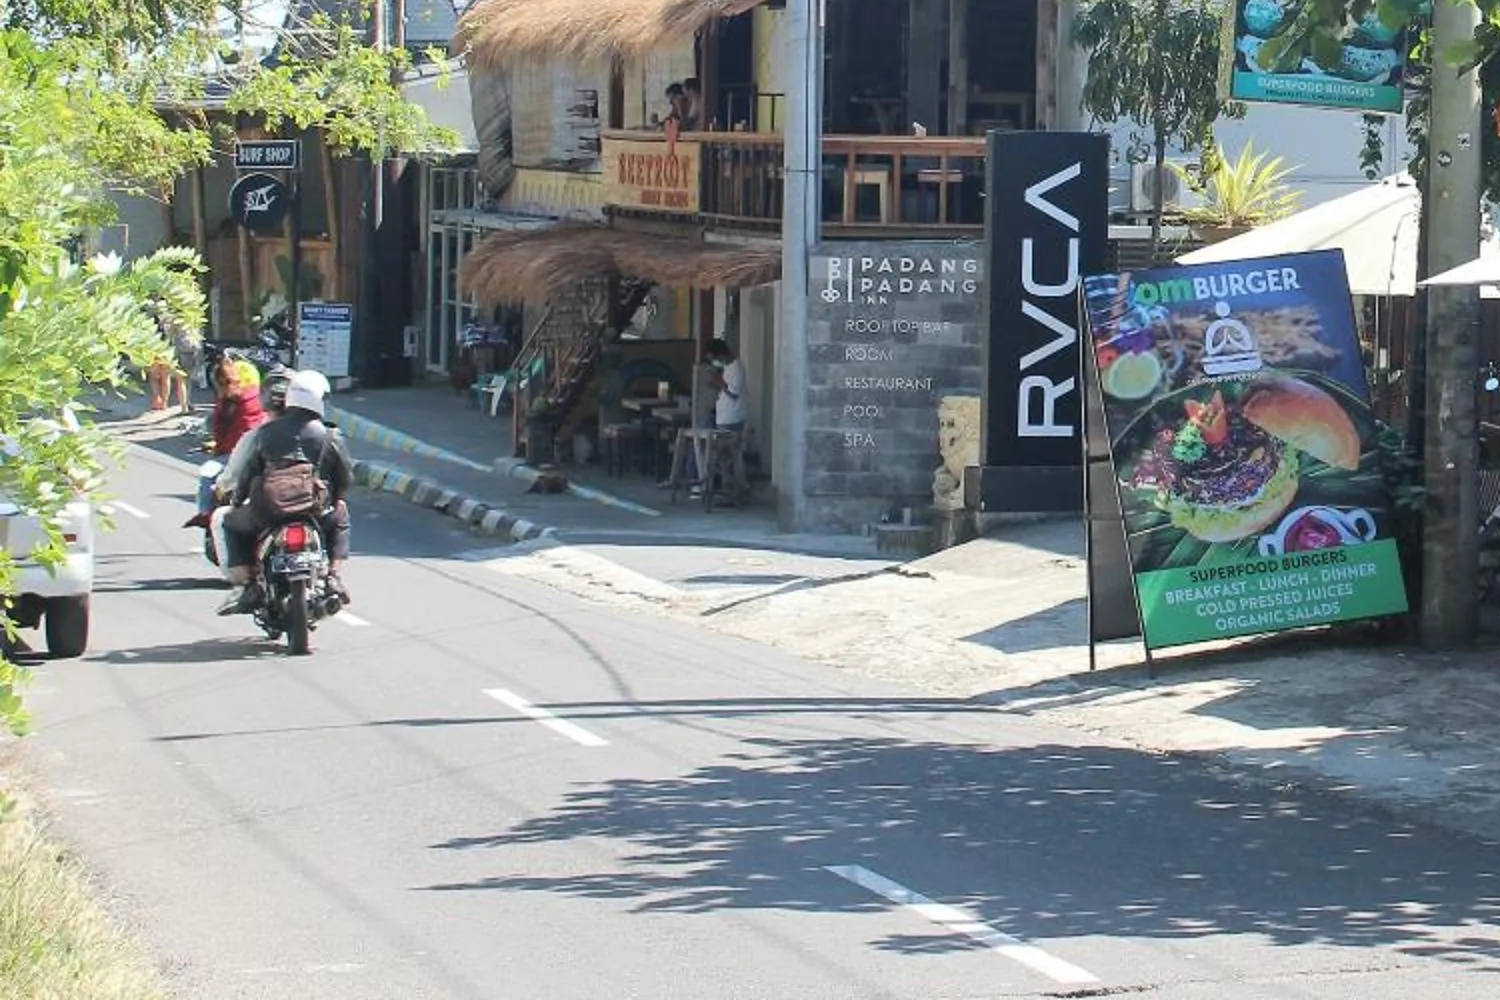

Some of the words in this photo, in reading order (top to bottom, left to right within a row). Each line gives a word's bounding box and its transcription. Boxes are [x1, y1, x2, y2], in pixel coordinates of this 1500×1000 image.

[239, 147, 263, 162] SURF
[266, 147, 291, 161] SHOP
[861, 257, 977, 273] PADANG
[861, 278, 977, 293] PADANG
[1017, 162, 1081, 438] RVCA
[845, 348, 894, 361] ROOM
[845, 377, 933, 391] RESTAURANT
[843, 405, 885, 417] POOL
[844, 433, 876, 447] SPA
[1190, 560, 1278, 583] SUPERFOOD
[1282, 550, 1347, 570] BURGERS
[1165, 582, 1247, 605] BREAKFAST
[1259, 574, 1309, 592] LUNCH
[1321, 563, 1378, 582] DINNER
[1196, 601, 1236, 618] COLD
[1239, 592, 1301, 611] PRESSED
[1303, 583, 1353, 602] JUICES
[1215, 612, 1284, 631] ORGANIC
[1286, 601, 1341, 621] SALADS
